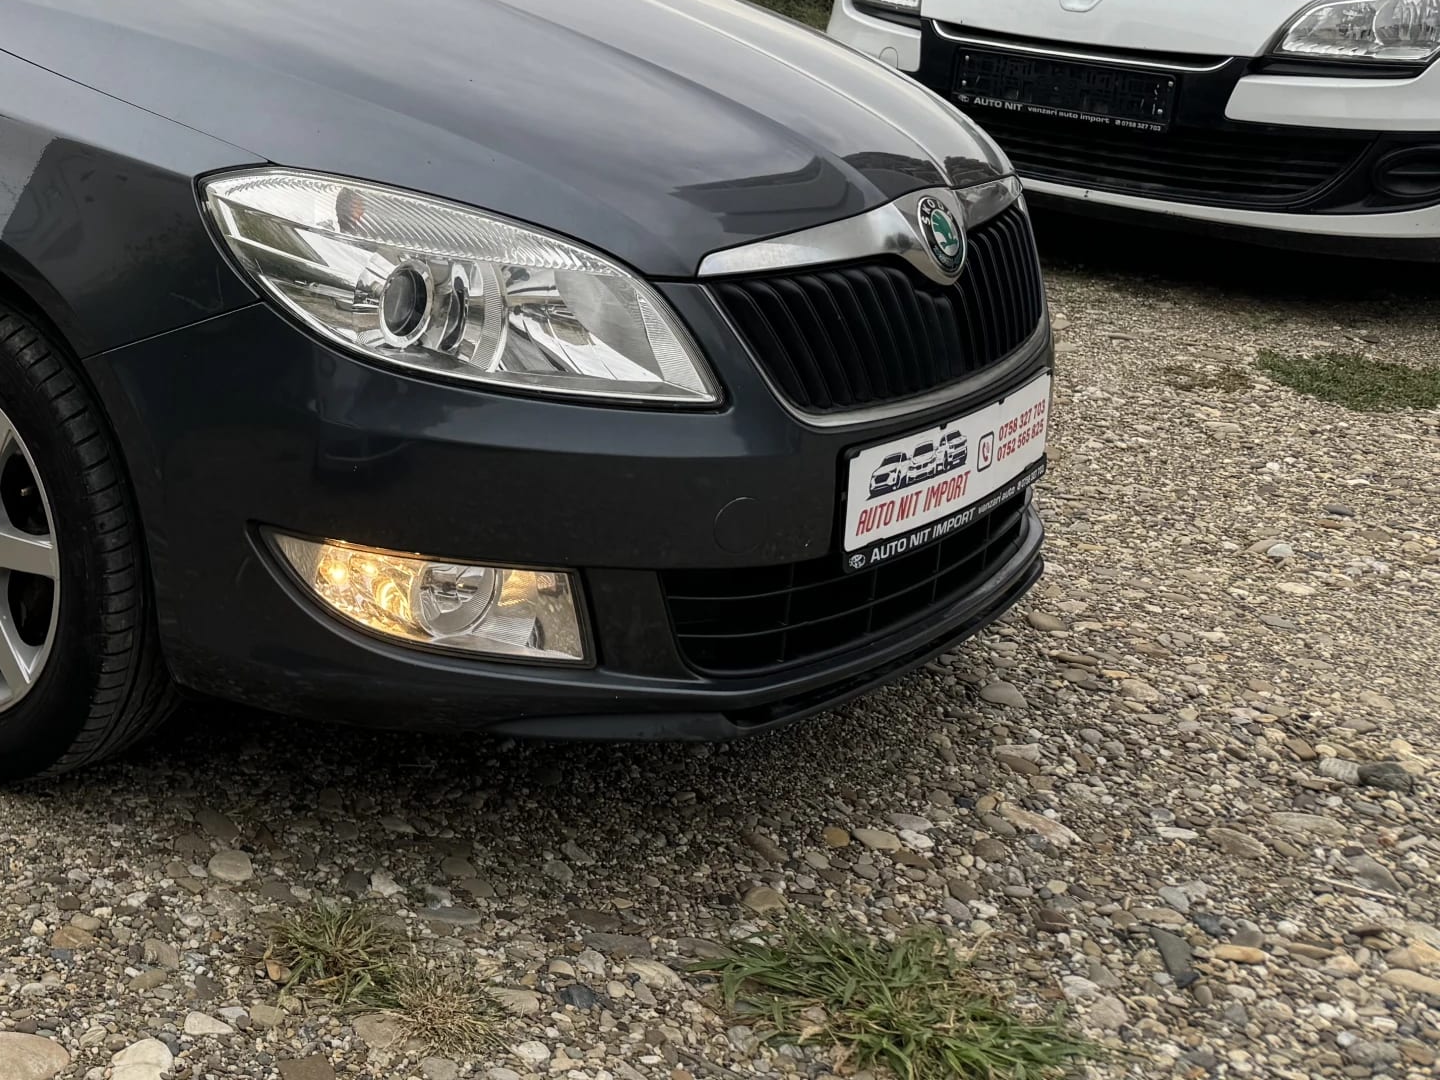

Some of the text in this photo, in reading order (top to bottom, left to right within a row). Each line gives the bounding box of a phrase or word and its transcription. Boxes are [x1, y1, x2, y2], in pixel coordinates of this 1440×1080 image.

[973, 96, 1003, 109] AUTO
[1004, 101, 1023, 112] NIT
[1059, 110, 1078, 119] auto
[1080, 113, 1110, 124] import
[998, 416, 1018, 442] 0758
[1019, 407, 1033, 429] 327
[856, 471, 971, 537] AUTO NIT IMPORT
[870, 537, 907, 563] AUTO
[909, 528, 931, 548] NIT
[932, 507, 976, 538] IMPORT
